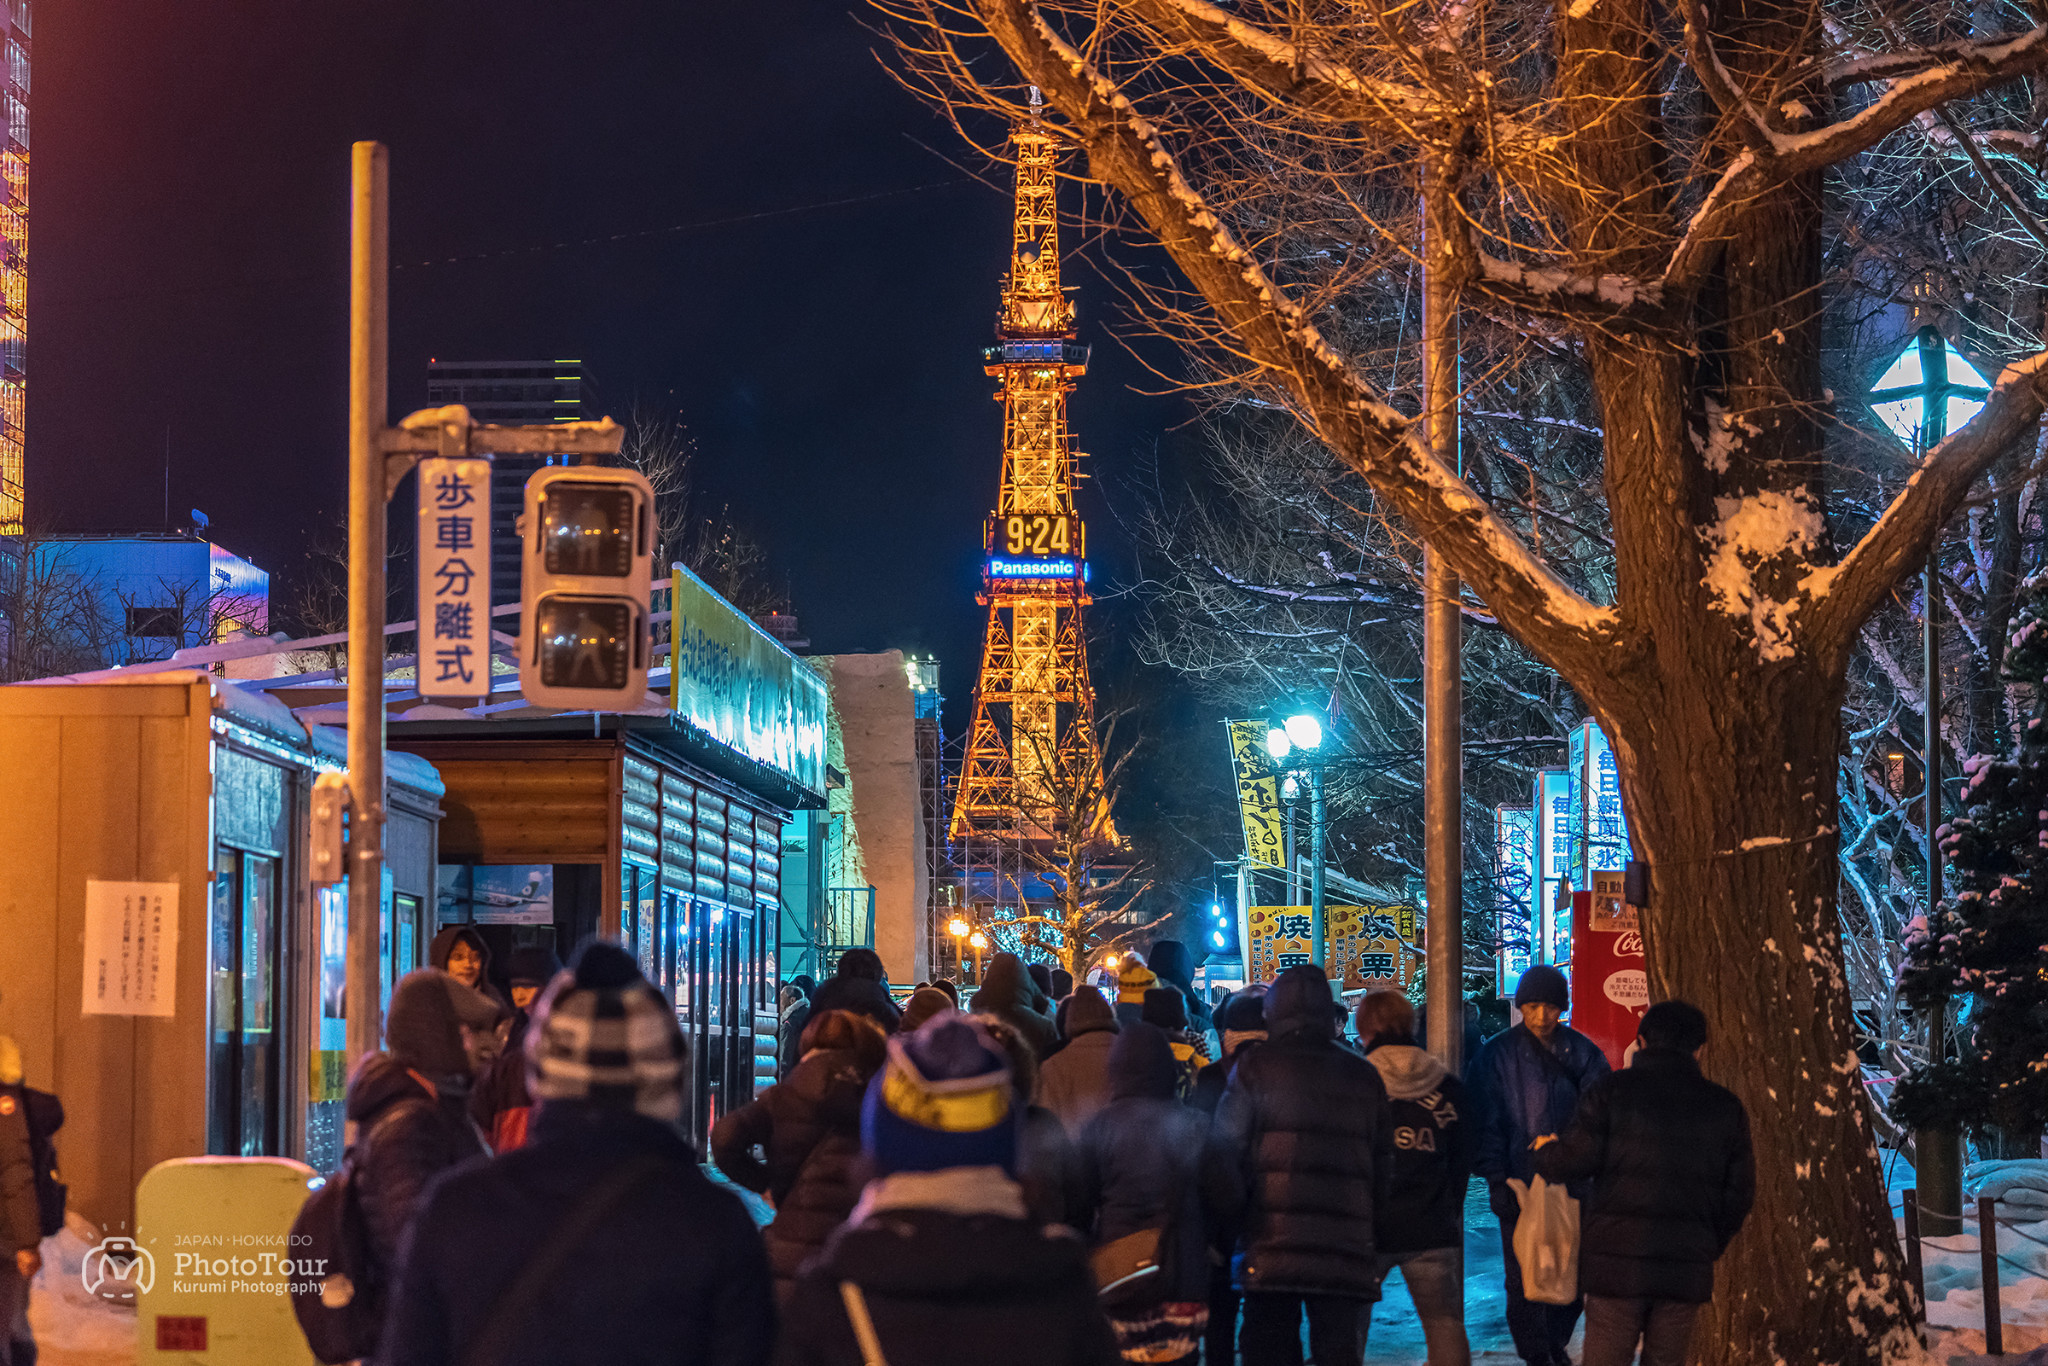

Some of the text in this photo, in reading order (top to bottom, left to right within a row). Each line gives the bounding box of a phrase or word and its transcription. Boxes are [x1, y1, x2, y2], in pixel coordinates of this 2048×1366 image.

[1006, 516, 1070, 554] 9:24
[434, 473, 475, 684] 歩車分離式
[991, 560, 1073, 575] Panasonic
[1597, 750, 1619, 836] 毎日新聞
[1552, 796, 1570, 874] 毎日新聞
[1597, 881, 1625, 893] 自動
[1264, 935, 1274, 962] 栗の実が
[1613, 930, 1644, 958] Coc
